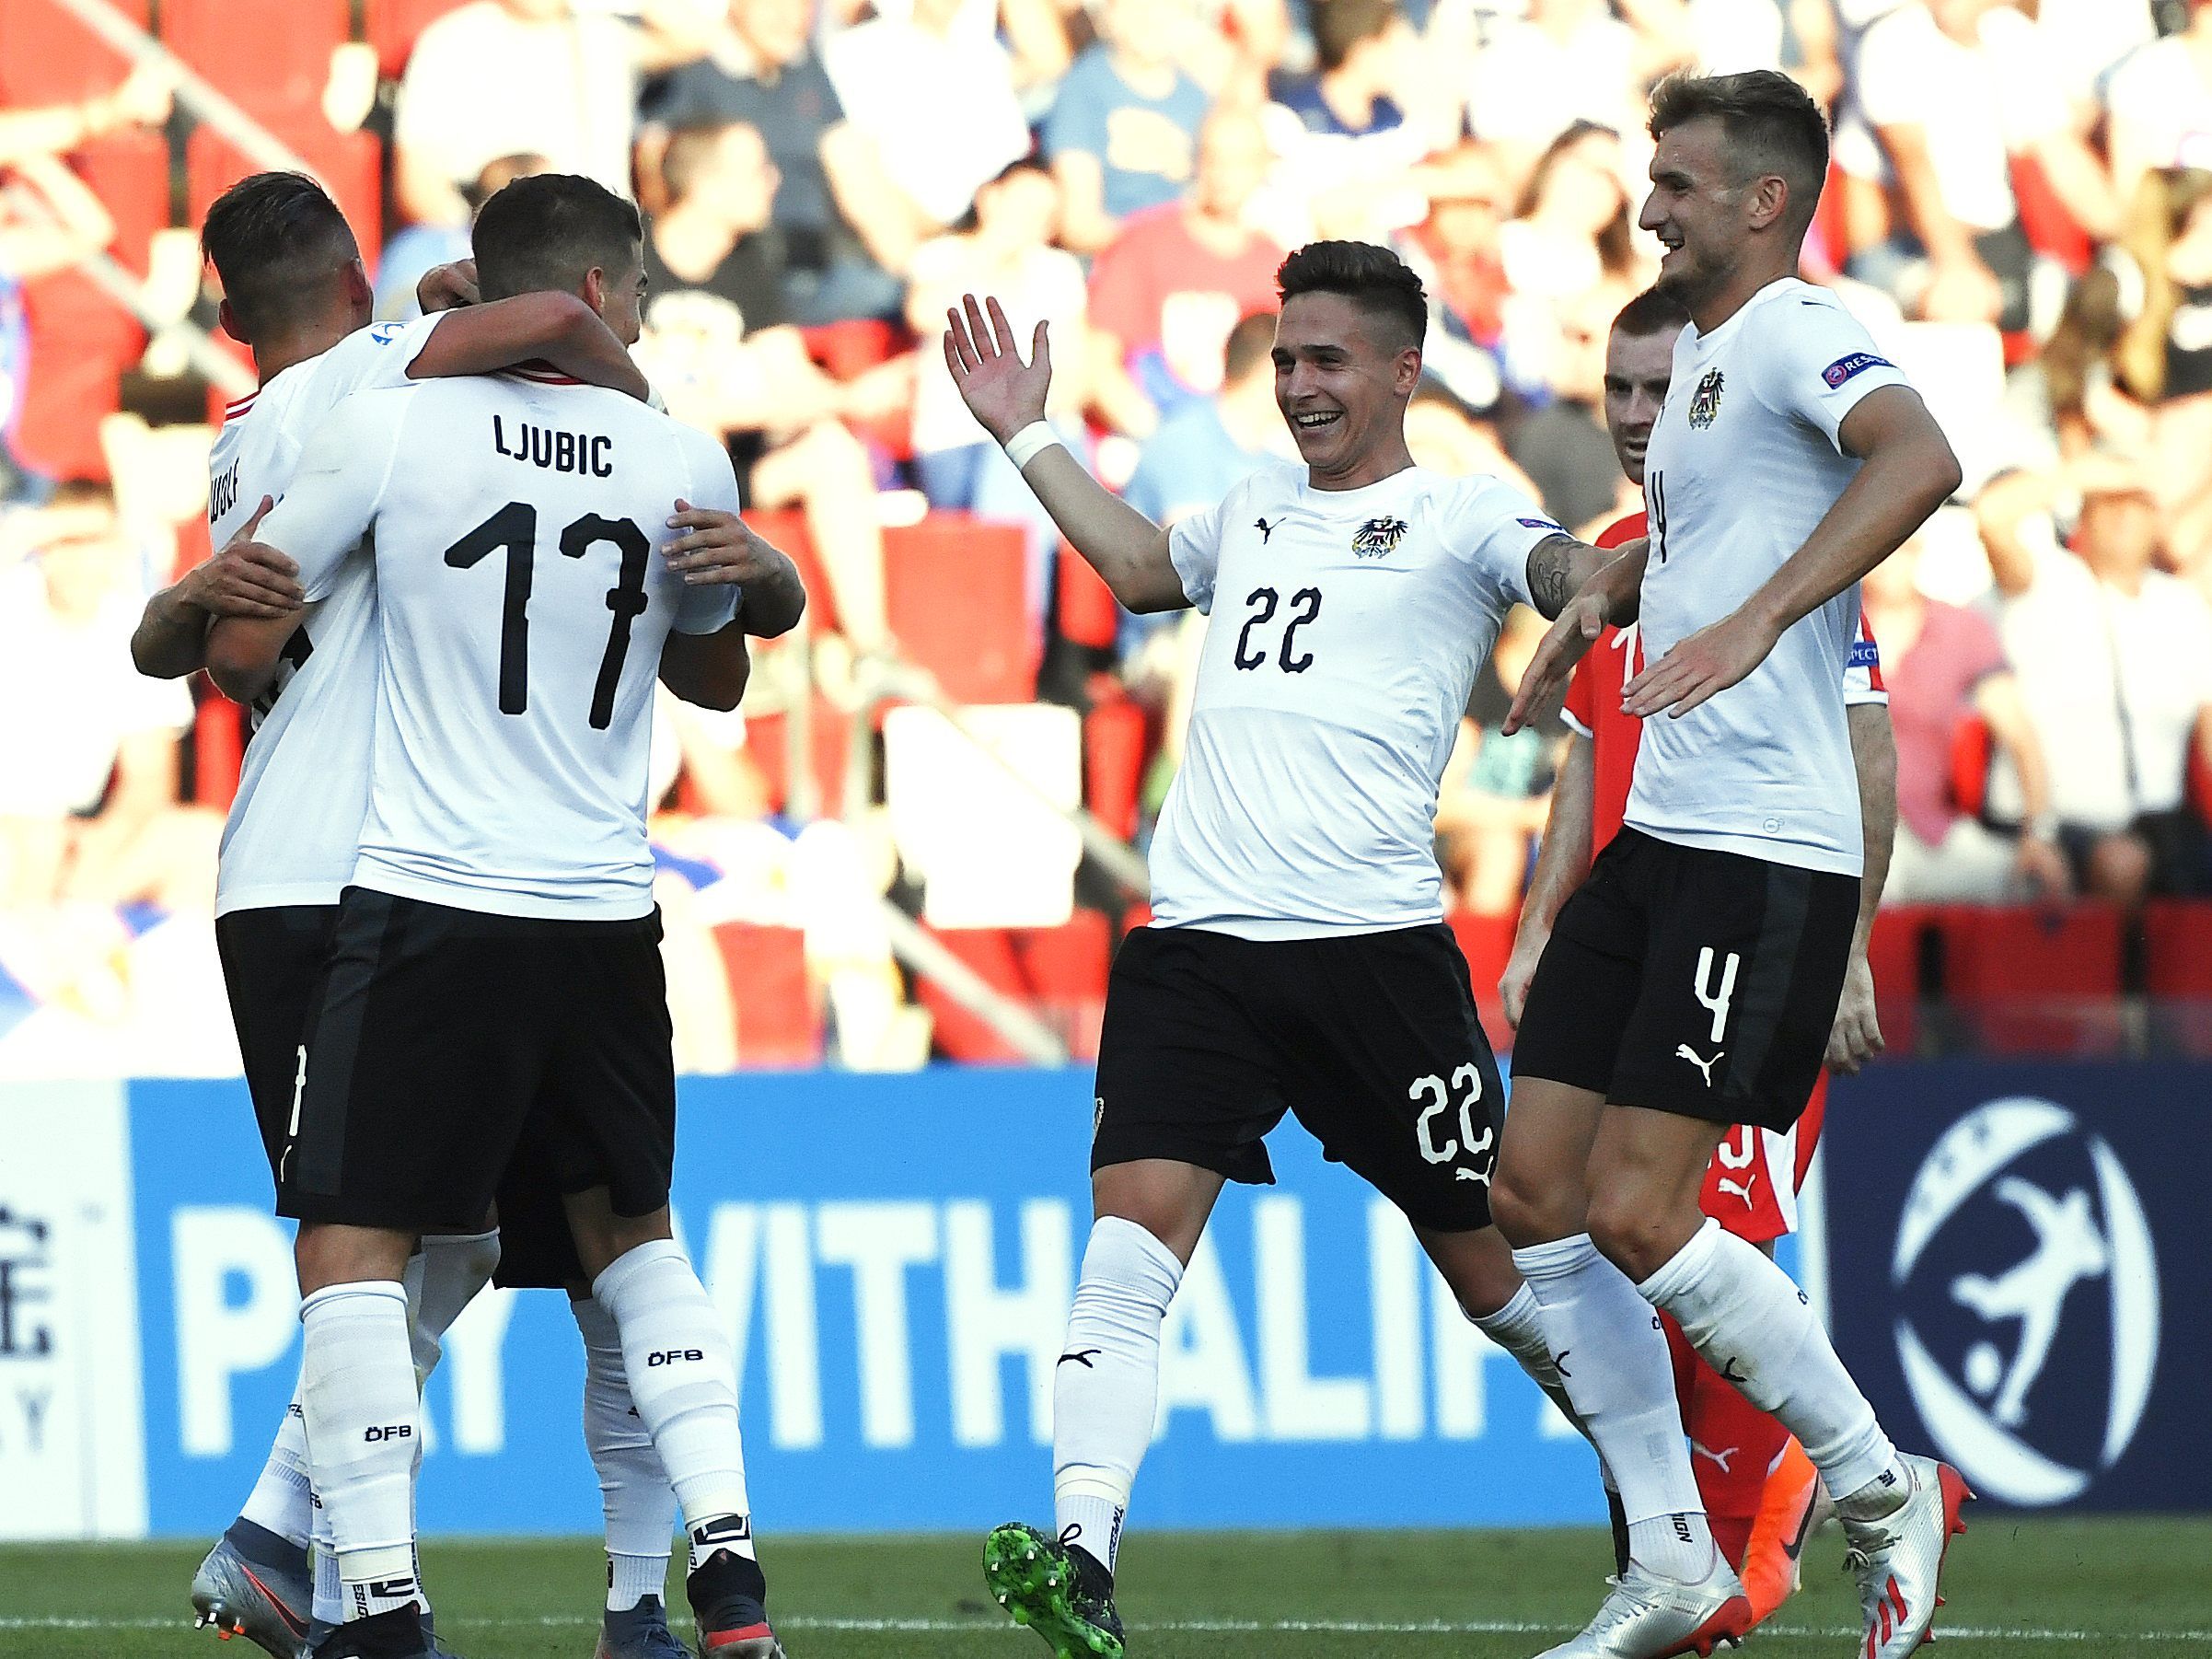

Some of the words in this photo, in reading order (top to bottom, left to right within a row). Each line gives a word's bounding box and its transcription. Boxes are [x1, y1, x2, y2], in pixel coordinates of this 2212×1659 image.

[493, 414, 612, 478] LJUBIC
[445, 502, 650, 730] 17
[1234, 587, 1322, 673] 22
[1695, 946, 1740, 1043] 4
[1409, 1062, 1493, 1165] 22
[648, 1350, 703, 1367] ÖFB
[365, 1425, 411, 1442] ÖFB
